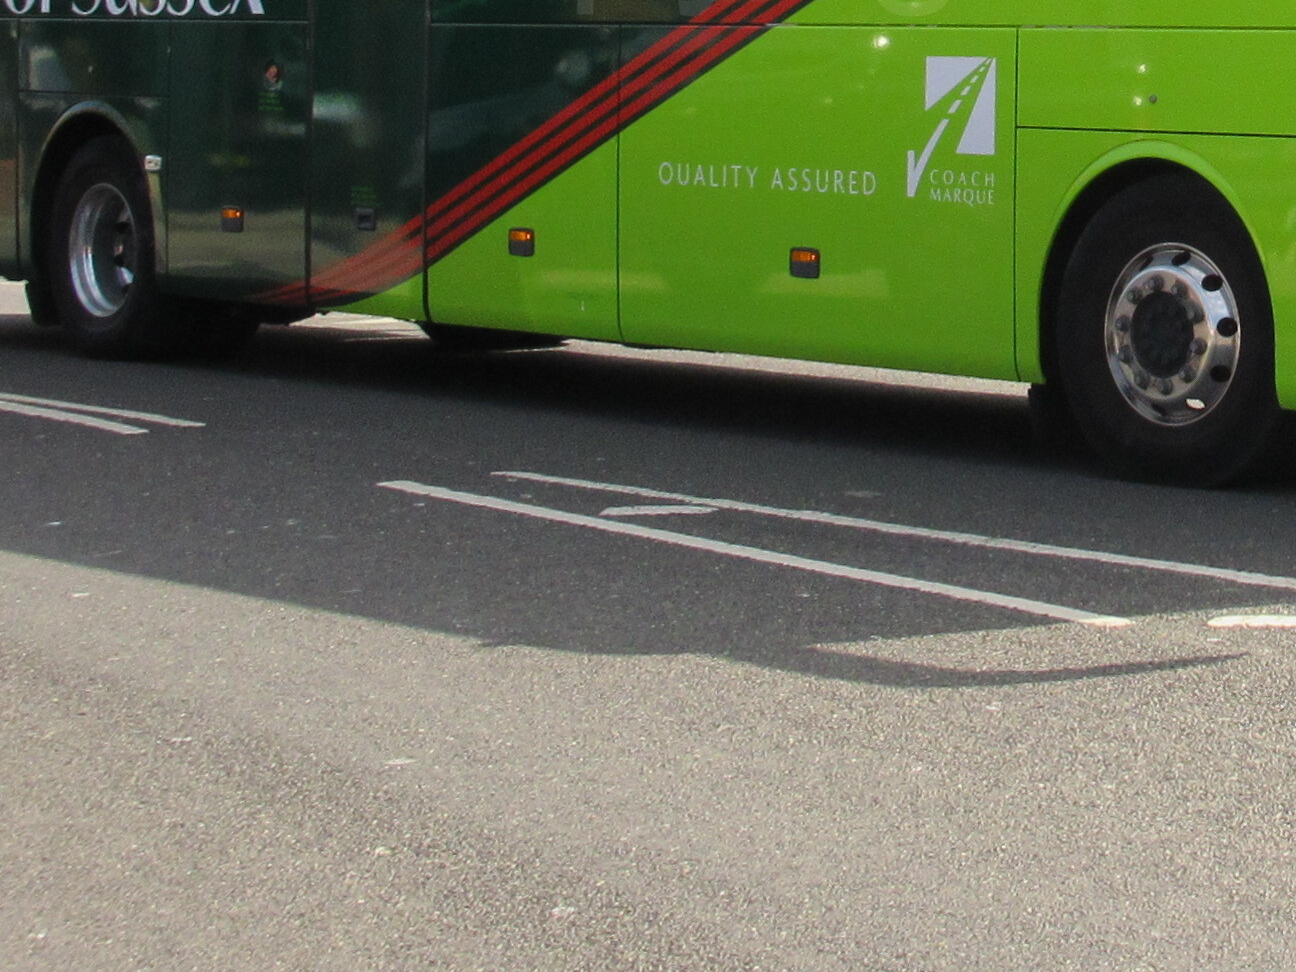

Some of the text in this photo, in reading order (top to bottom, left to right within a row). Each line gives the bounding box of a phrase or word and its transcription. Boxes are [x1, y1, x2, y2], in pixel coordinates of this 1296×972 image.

[658, 161, 877, 195] QUALITY ASSURED
[930, 169, 995, 187] COACH
[930, 187, 995, 207] MARQUE
